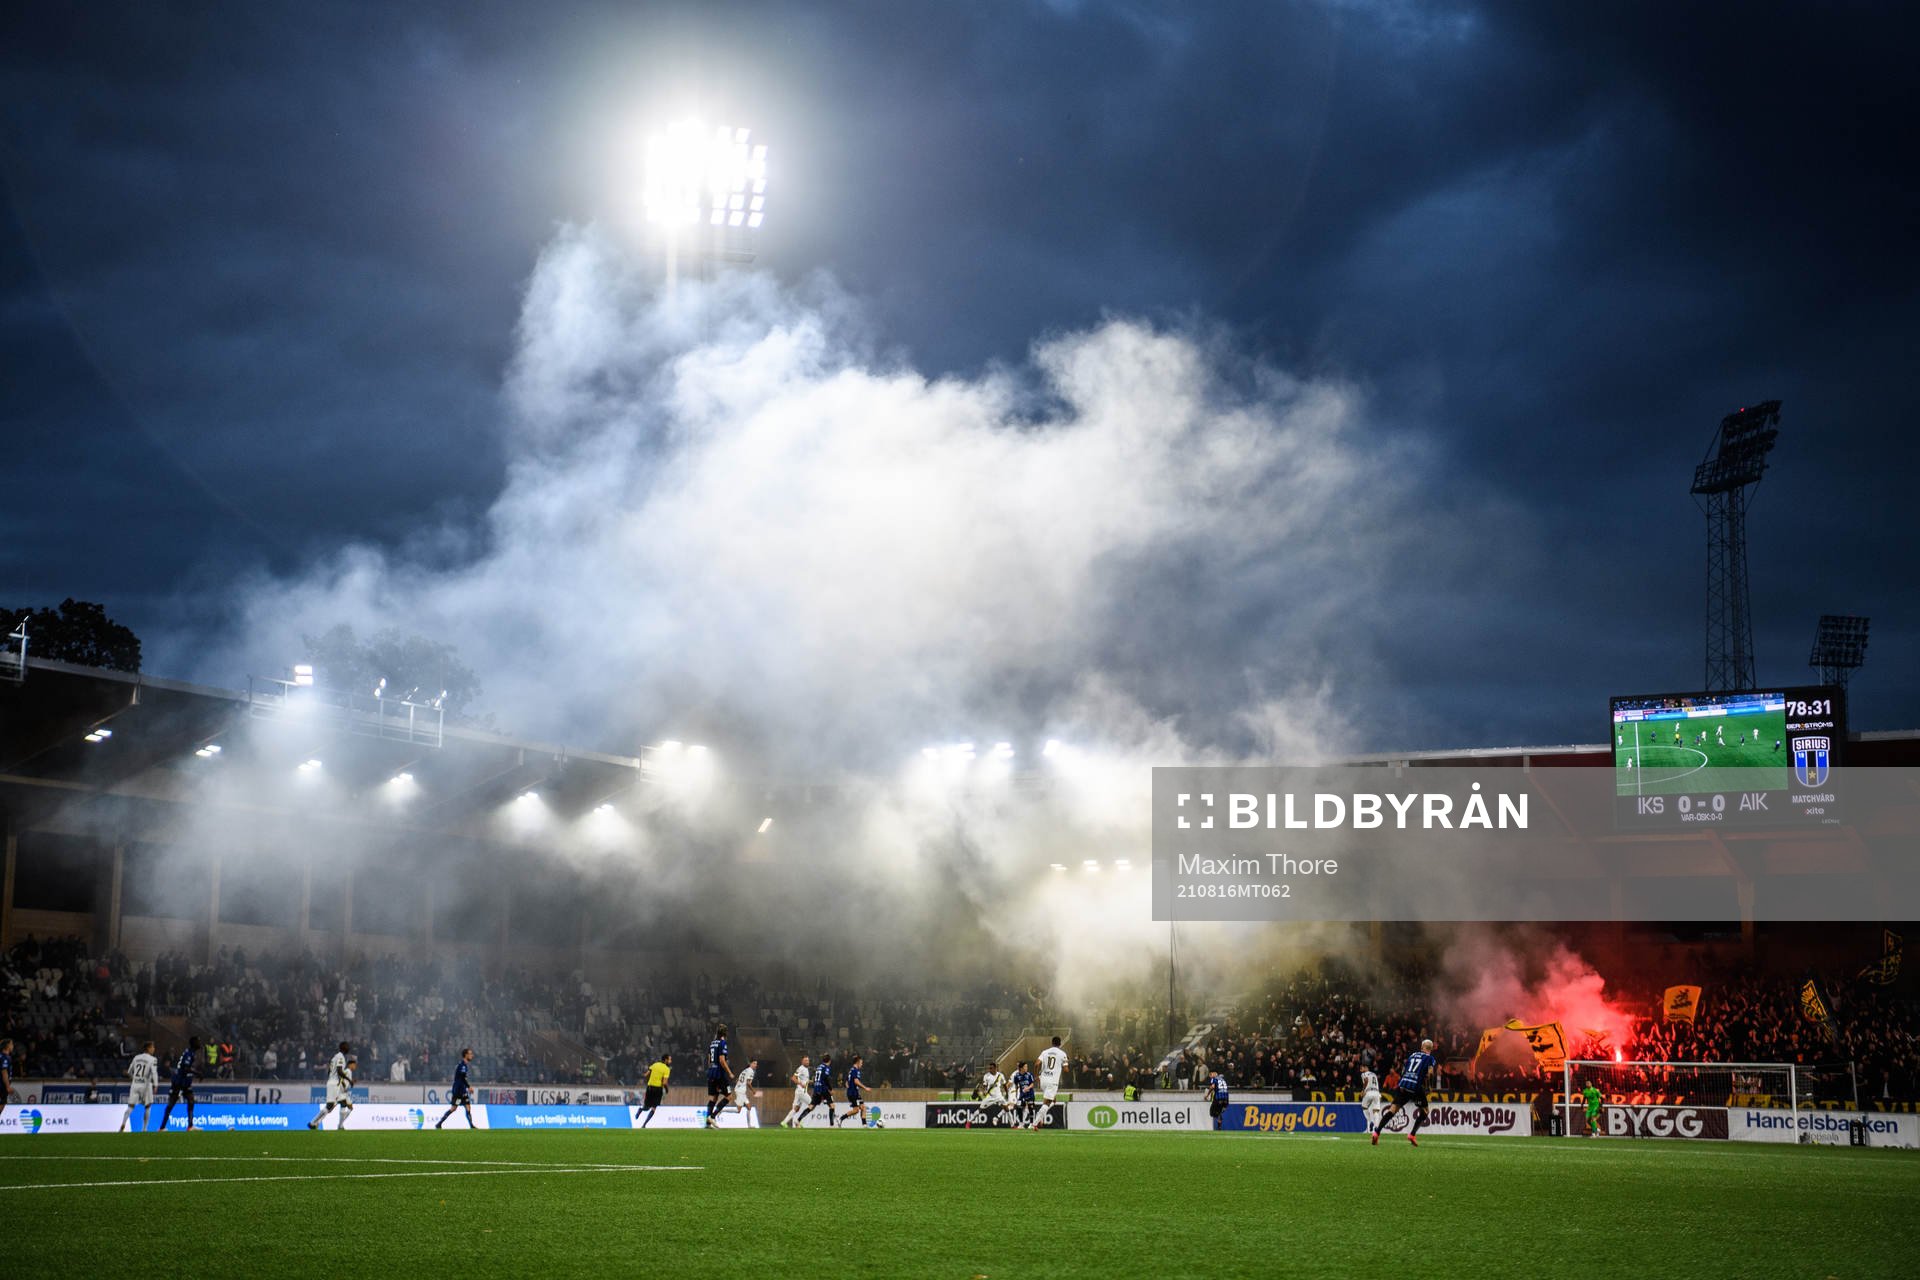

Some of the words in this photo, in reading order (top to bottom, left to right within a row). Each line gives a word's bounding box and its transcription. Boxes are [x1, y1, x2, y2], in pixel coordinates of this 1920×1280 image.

[1786, 699, 1831, 716] 78:31
[1795, 739, 1827, 750] SIRIUS
[1638, 797, 1664, 814] IKS
[1739, 792, 1768, 811] AIK
[135, 1063, 147, 1079] 21
[1408, 1058, 1422, 1072] 17
[1608, 1107, 1704, 1138] BYGG
